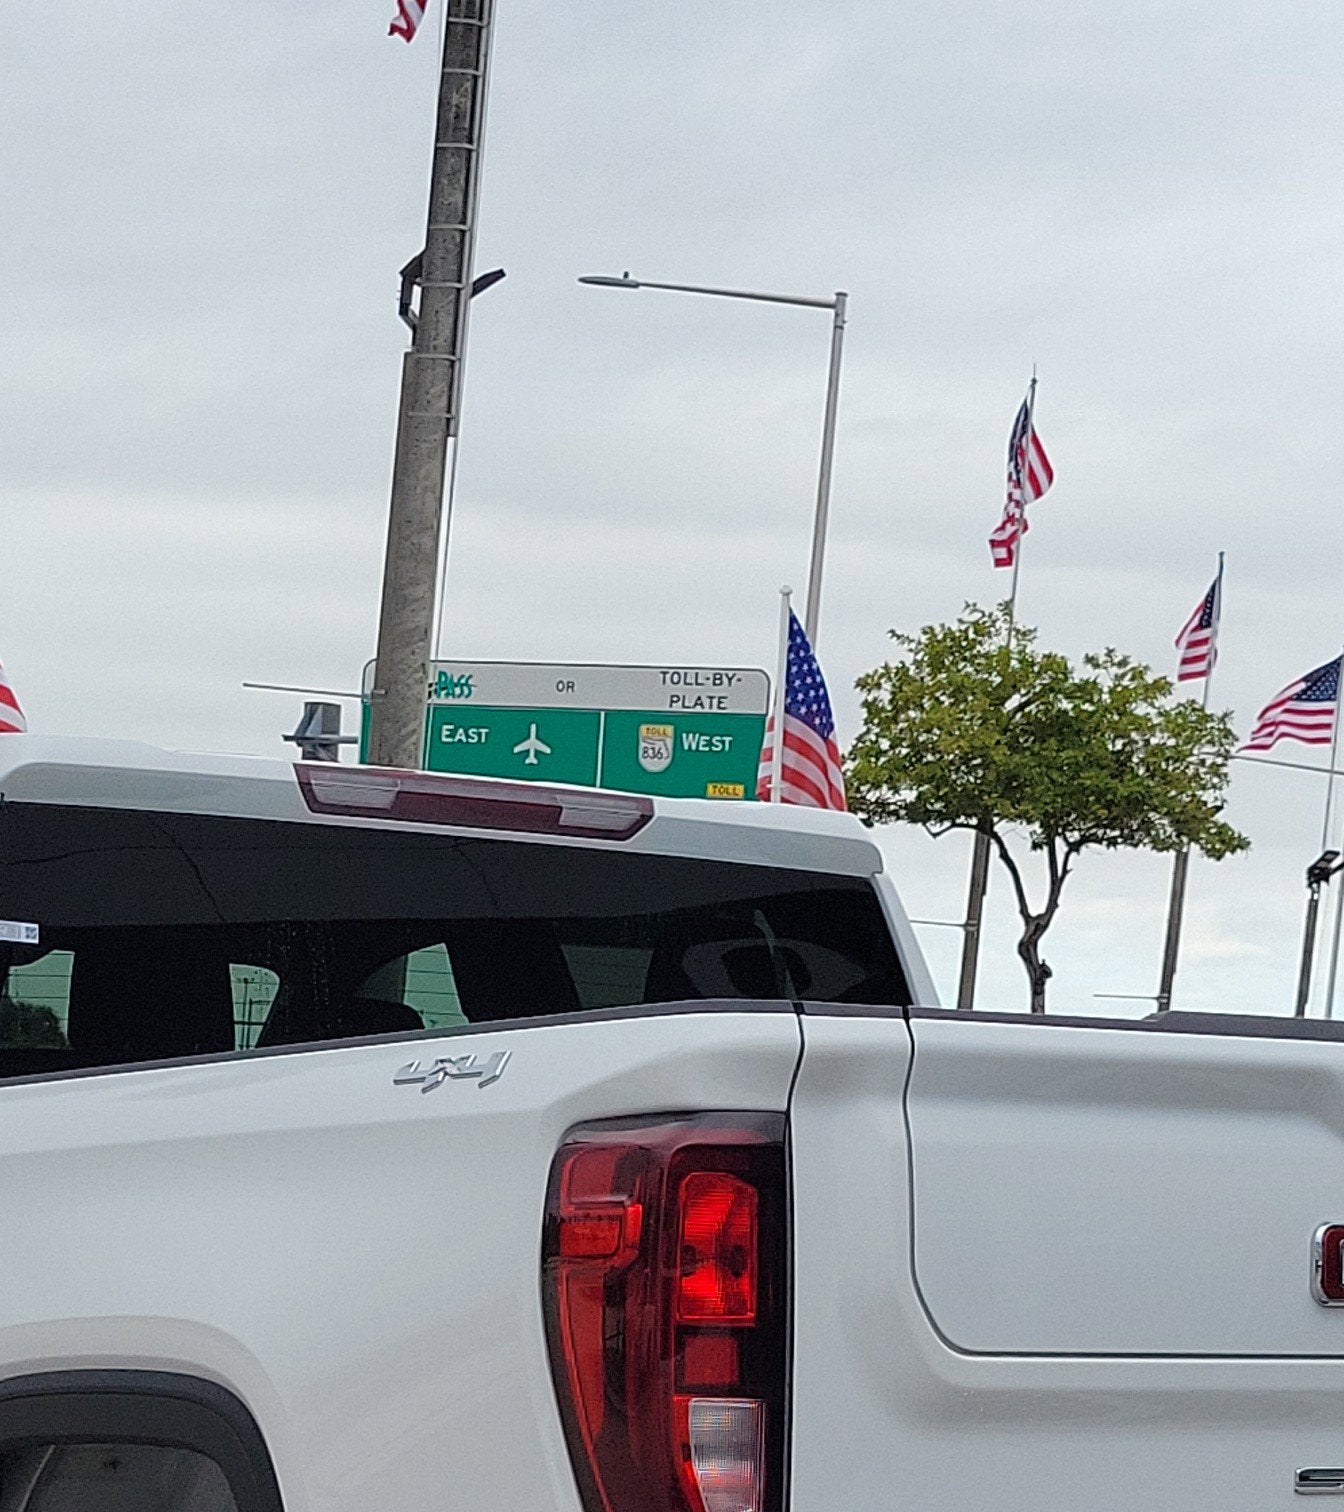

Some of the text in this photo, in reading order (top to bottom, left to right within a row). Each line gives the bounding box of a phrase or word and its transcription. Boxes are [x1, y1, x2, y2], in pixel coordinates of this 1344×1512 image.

[555, 679, 576, 693] OR
[659, 670, 743, 687] TOLL-BY-
[668, 694, 729, 711] PLATE
[440, 724, 490, 744] EAST
[645, 726, 669, 736] TOLL
[681, 732, 734, 752] WEST
[641, 746, 665, 760] 836
[711, 785, 740, 797] TOLL
